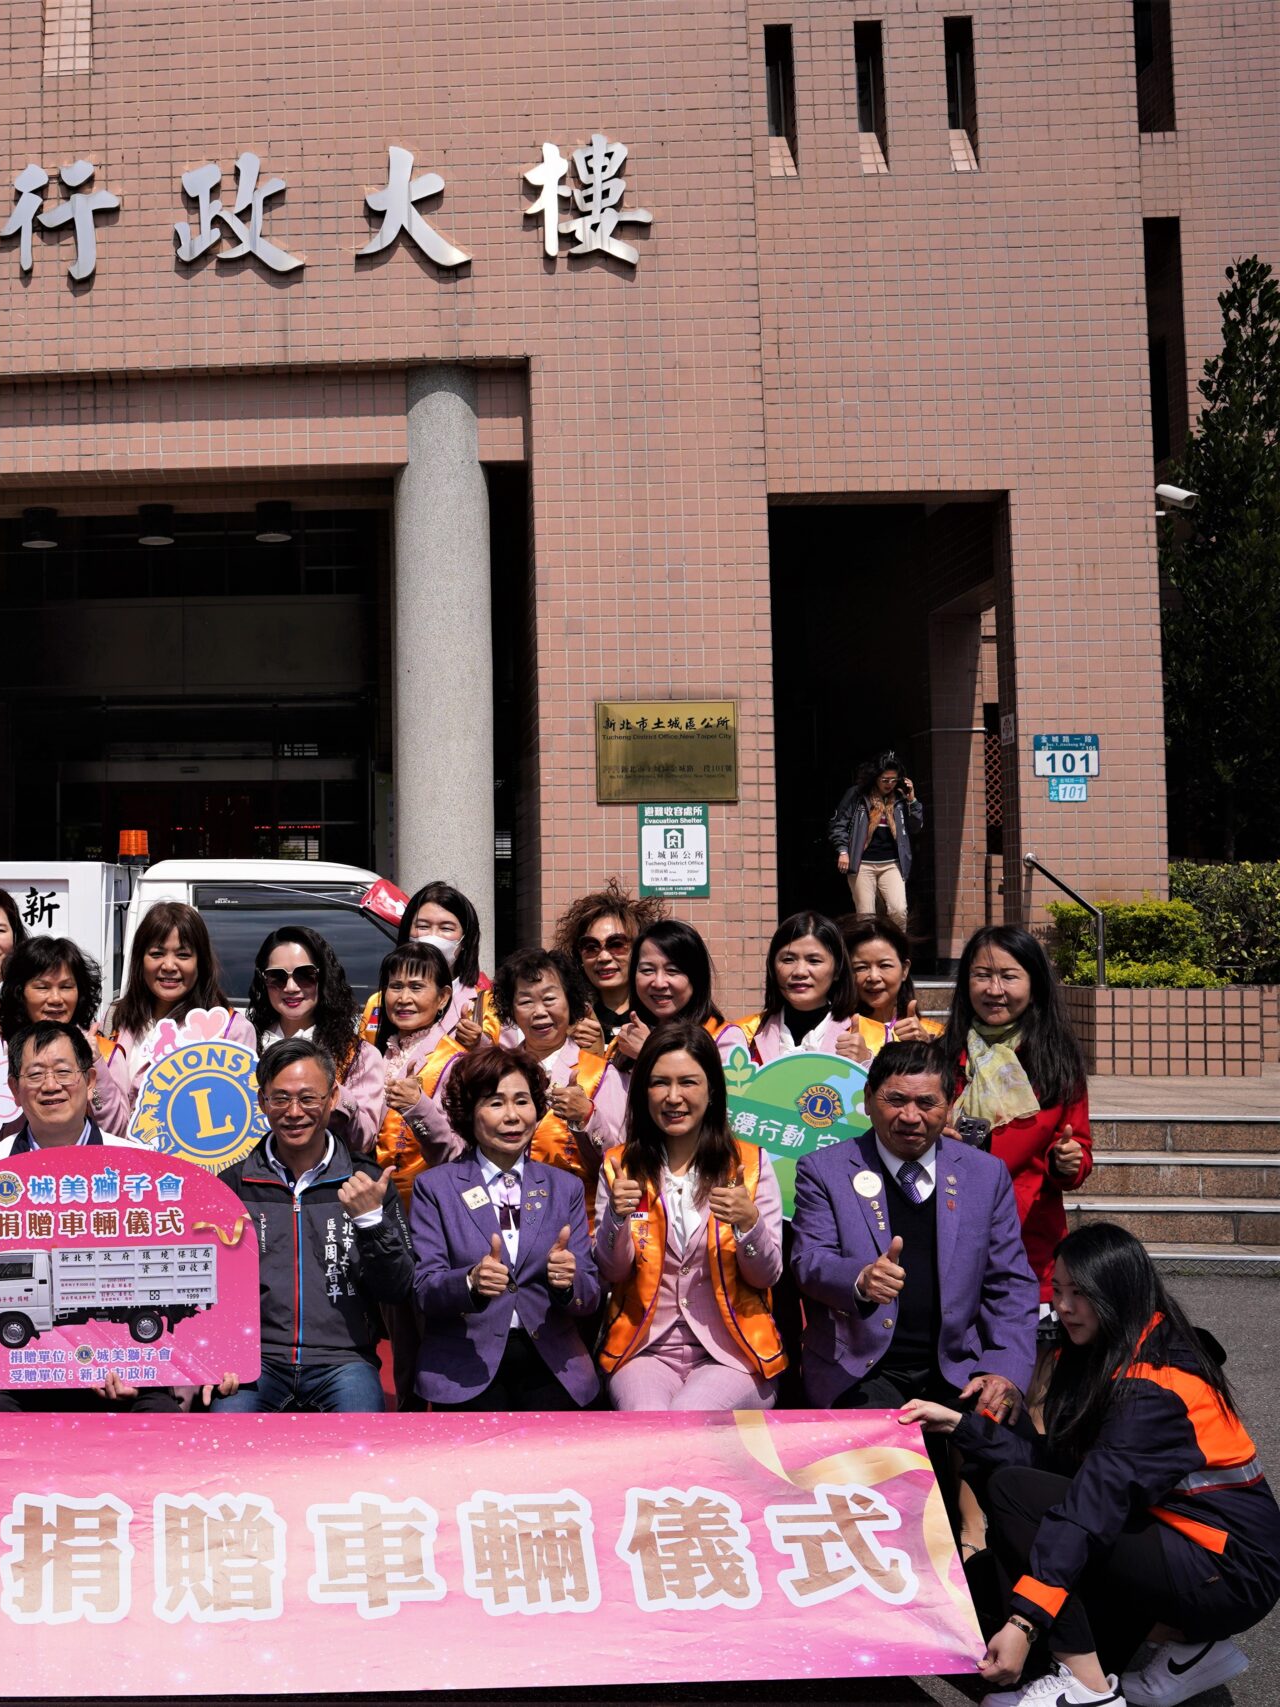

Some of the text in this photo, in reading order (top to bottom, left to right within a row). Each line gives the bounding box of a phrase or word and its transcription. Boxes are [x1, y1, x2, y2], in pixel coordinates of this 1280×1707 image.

[602, 716, 730, 732] 新北市土城區公所
[1046, 752, 1090, 773] 101
[1061, 786, 1084, 799] 101
[646, 851, 704, 860] 土城區公所
[22, 886, 61, 928] 新
[157, 1048, 245, 1086] LIONS
[810, 1085, 837, 1100] LIONS
[189, 1088, 235, 1139] L
[814, 1098, 827, 1115] L
[29, 1173, 182, 1202] 城美獅子會
[97, 1348, 171, 1362] 城美獅子會
